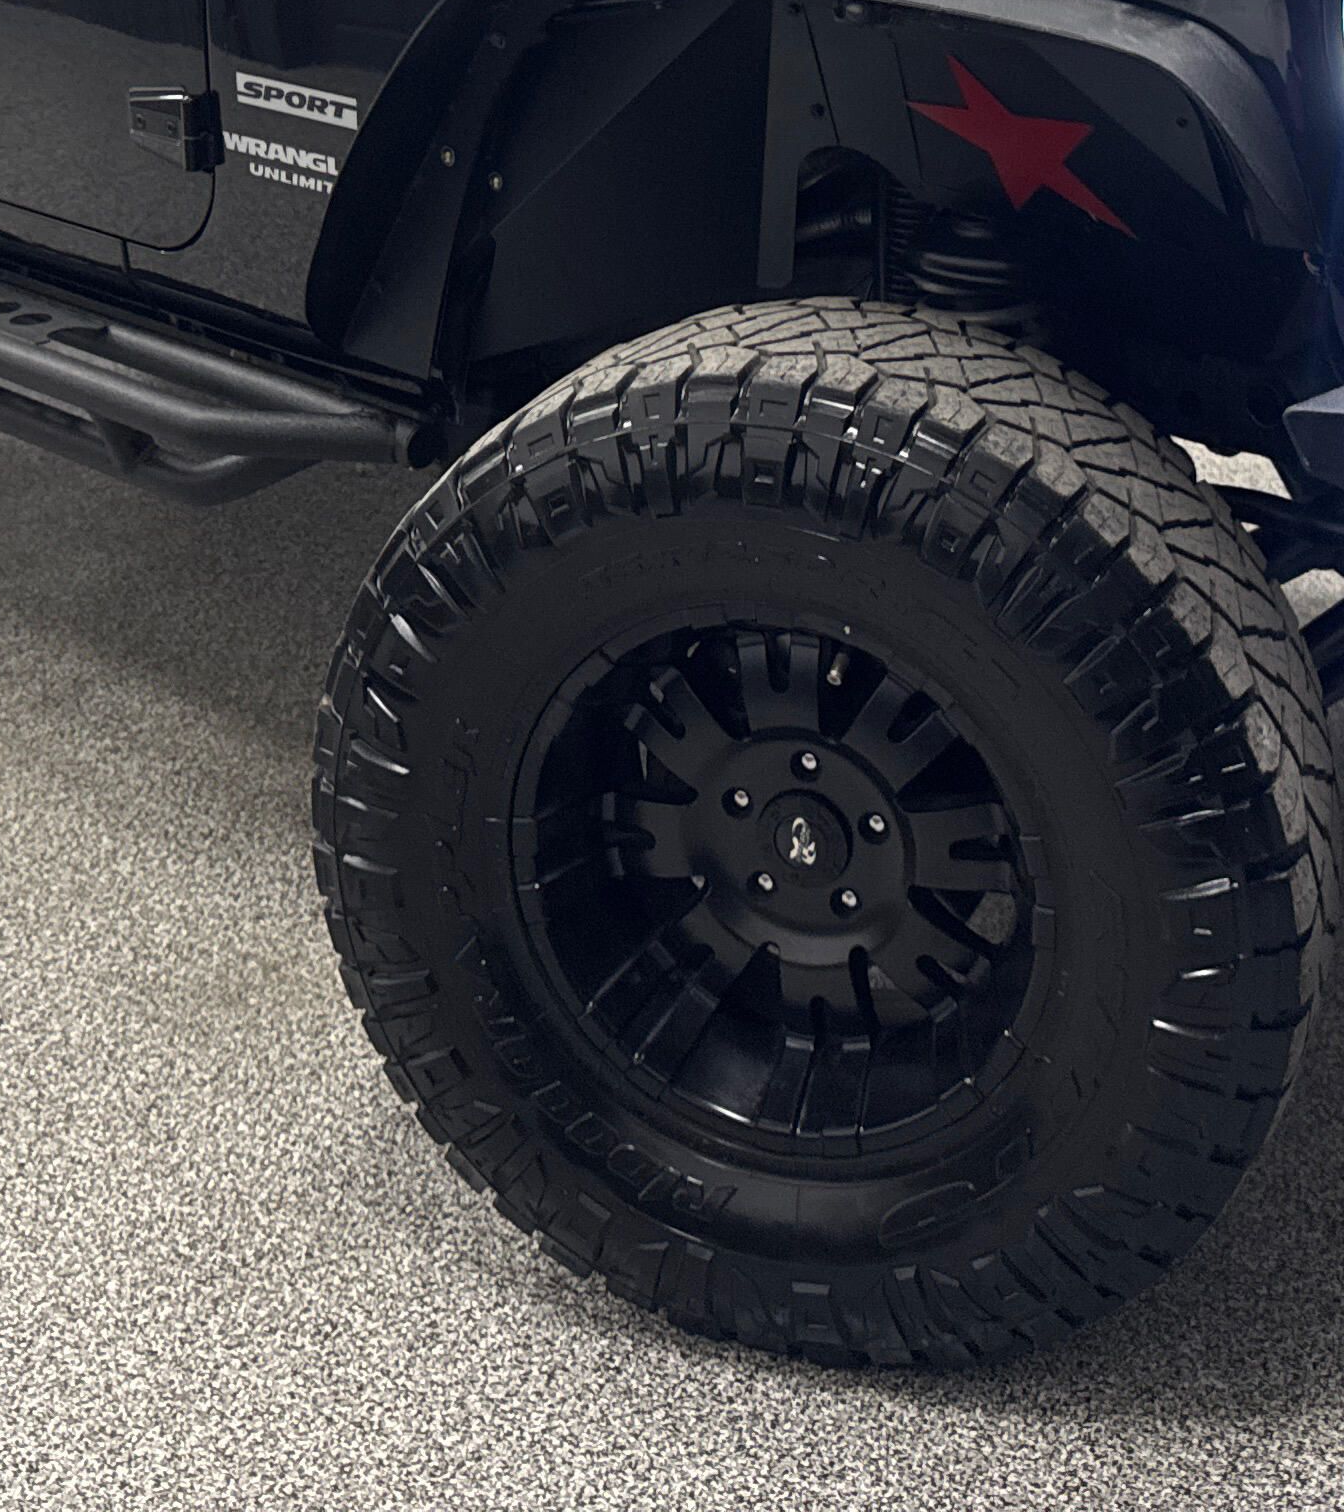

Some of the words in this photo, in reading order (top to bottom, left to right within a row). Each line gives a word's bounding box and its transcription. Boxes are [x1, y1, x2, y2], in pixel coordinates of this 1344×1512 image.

[238, 80, 358, 119] SPORT
[222, 130, 339, 176] WRANGL
[249, 162, 334, 195] UNLIMIT
